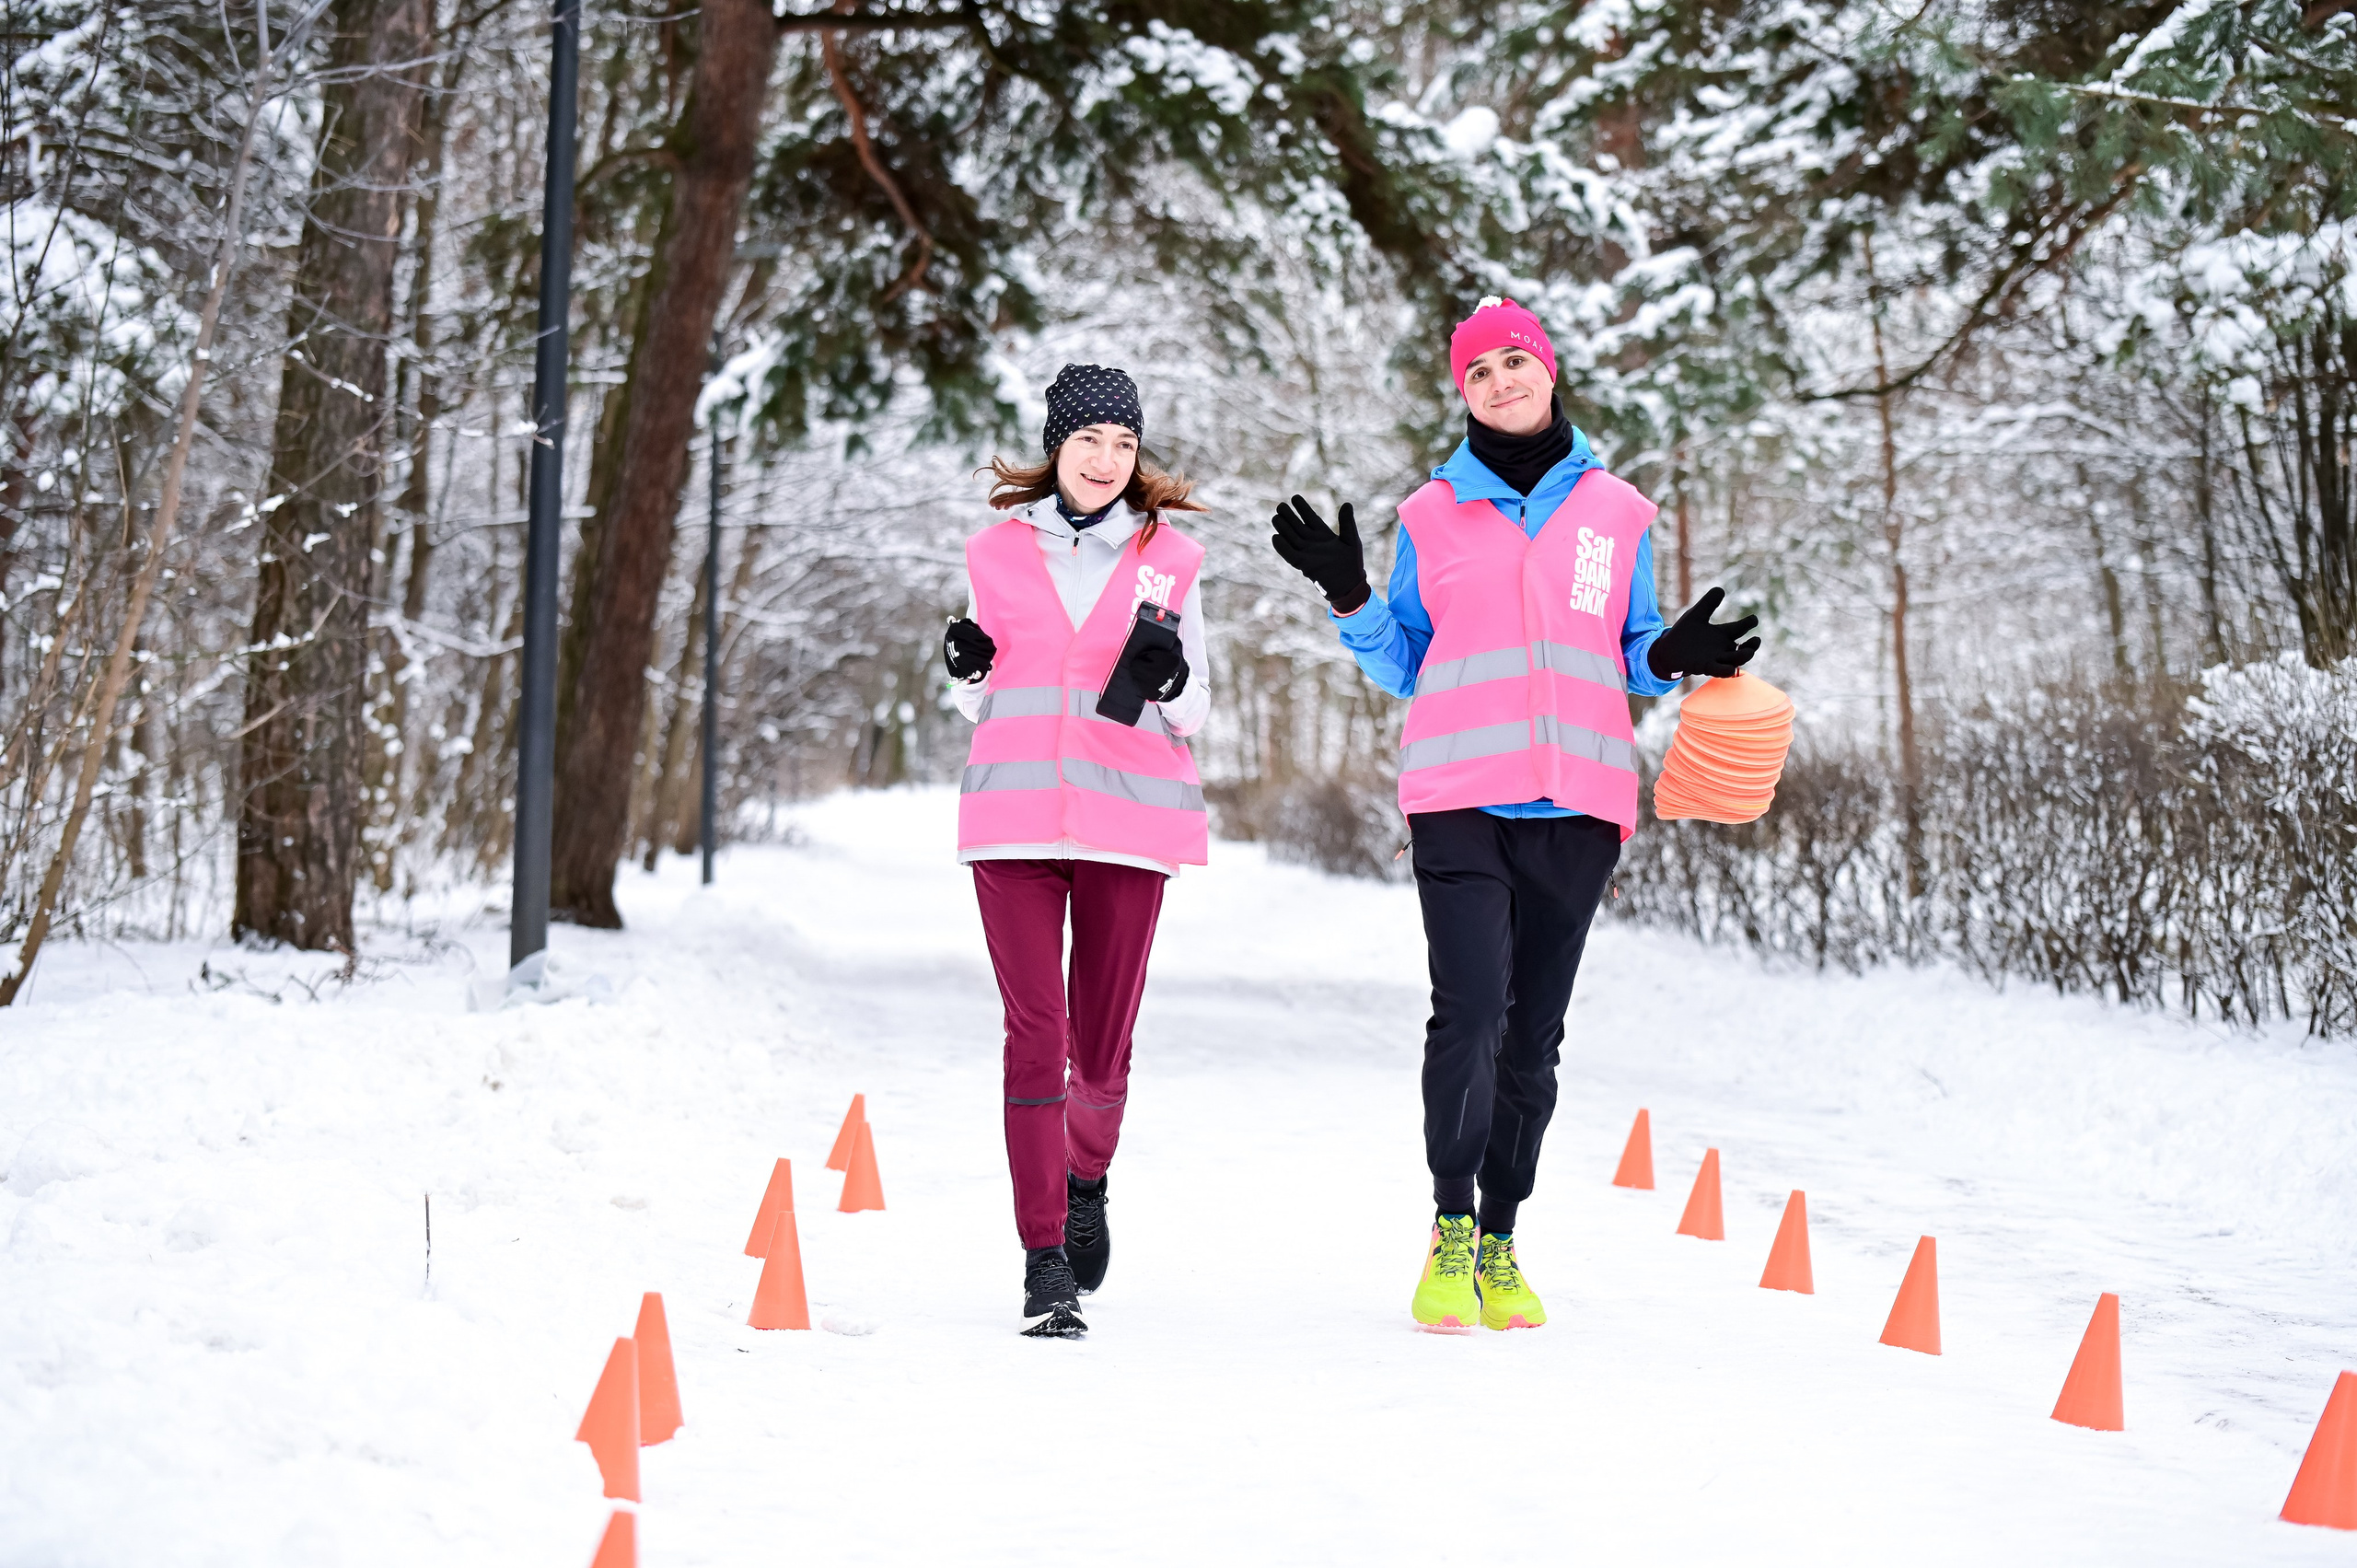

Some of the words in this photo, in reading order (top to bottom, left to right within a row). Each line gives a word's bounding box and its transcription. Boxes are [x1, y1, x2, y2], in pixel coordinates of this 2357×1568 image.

[1576, 527, 1615, 569] Sat
[1135, 565, 1176, 608] Sat
[1574, 558, 1611, 593] 9AM
